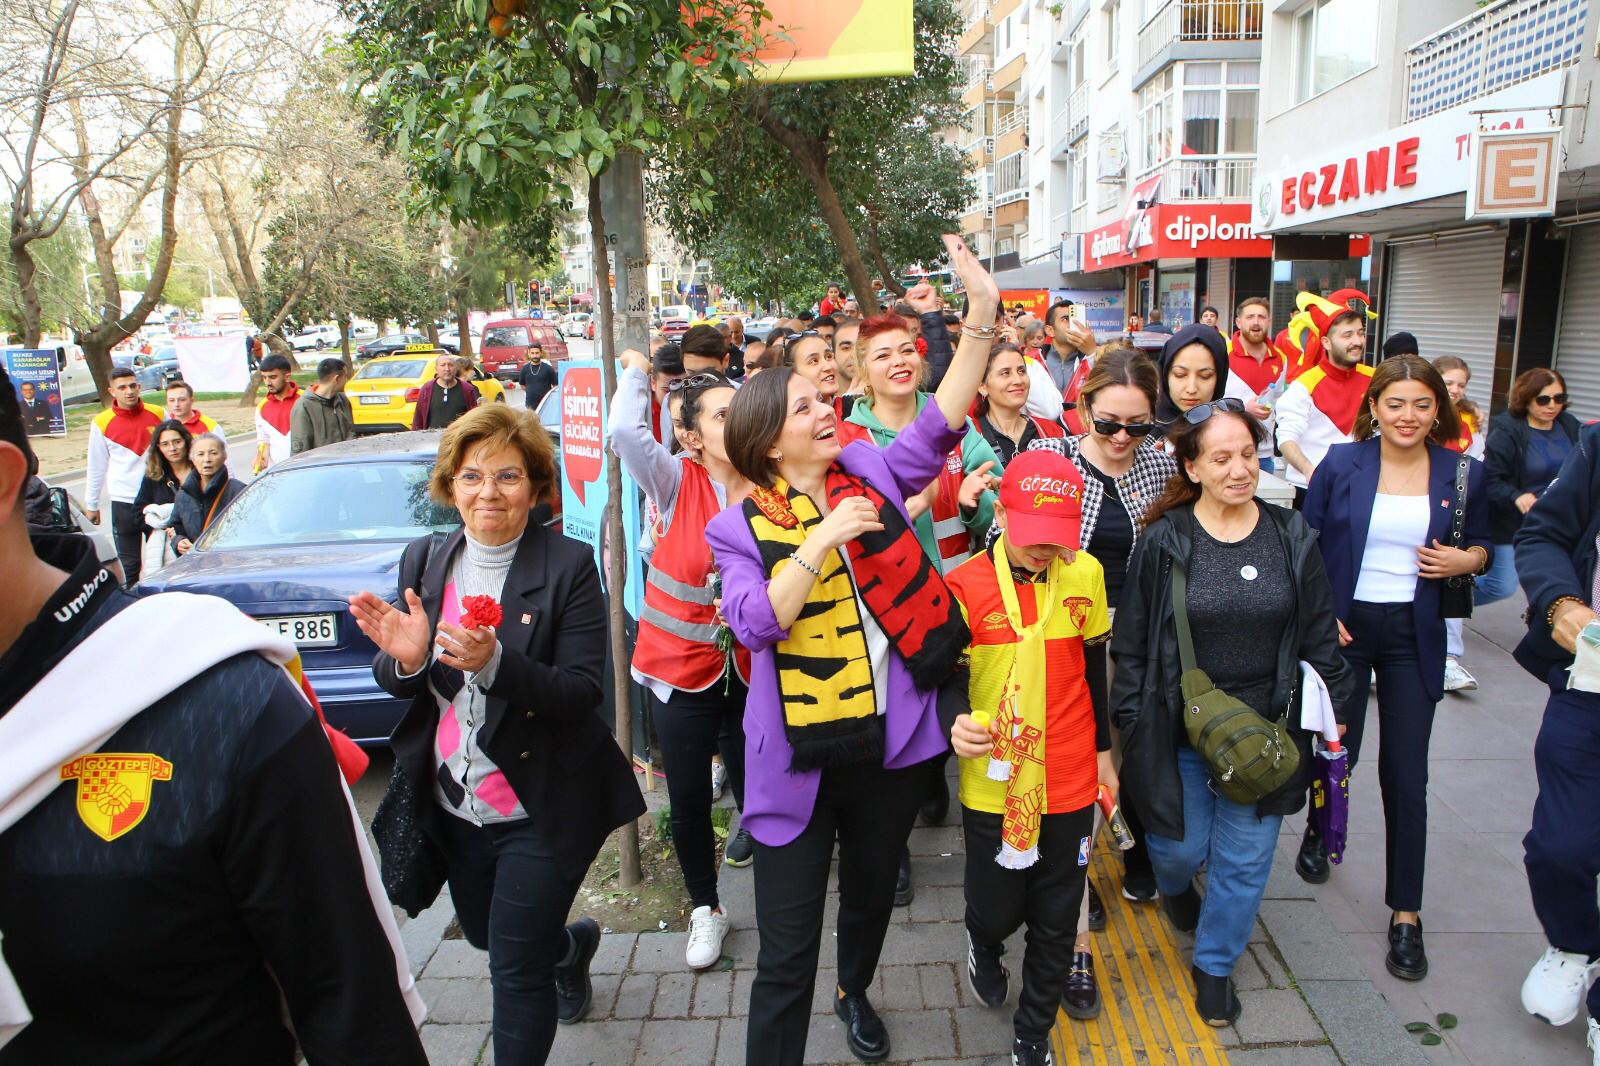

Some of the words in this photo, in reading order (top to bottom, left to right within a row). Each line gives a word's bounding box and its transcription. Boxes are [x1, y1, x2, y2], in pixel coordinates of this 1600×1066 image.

[1281, 137, 1420, 214] ECZANE
[1493, 147, 1538, 200] E
[1165, 215, 1273, 249] diplom
[565, 420, 600, 442] GÜCÜMÜZ
[565, 443, 601, 459] KARABAĞLAR
[1021, 474, 1077, 498] GÖZGÖZ
[54, 568, 109, 623] umbro
[294, 619, 331, 640] 886
[86, 756, 150, 771] GÖZTEPE
